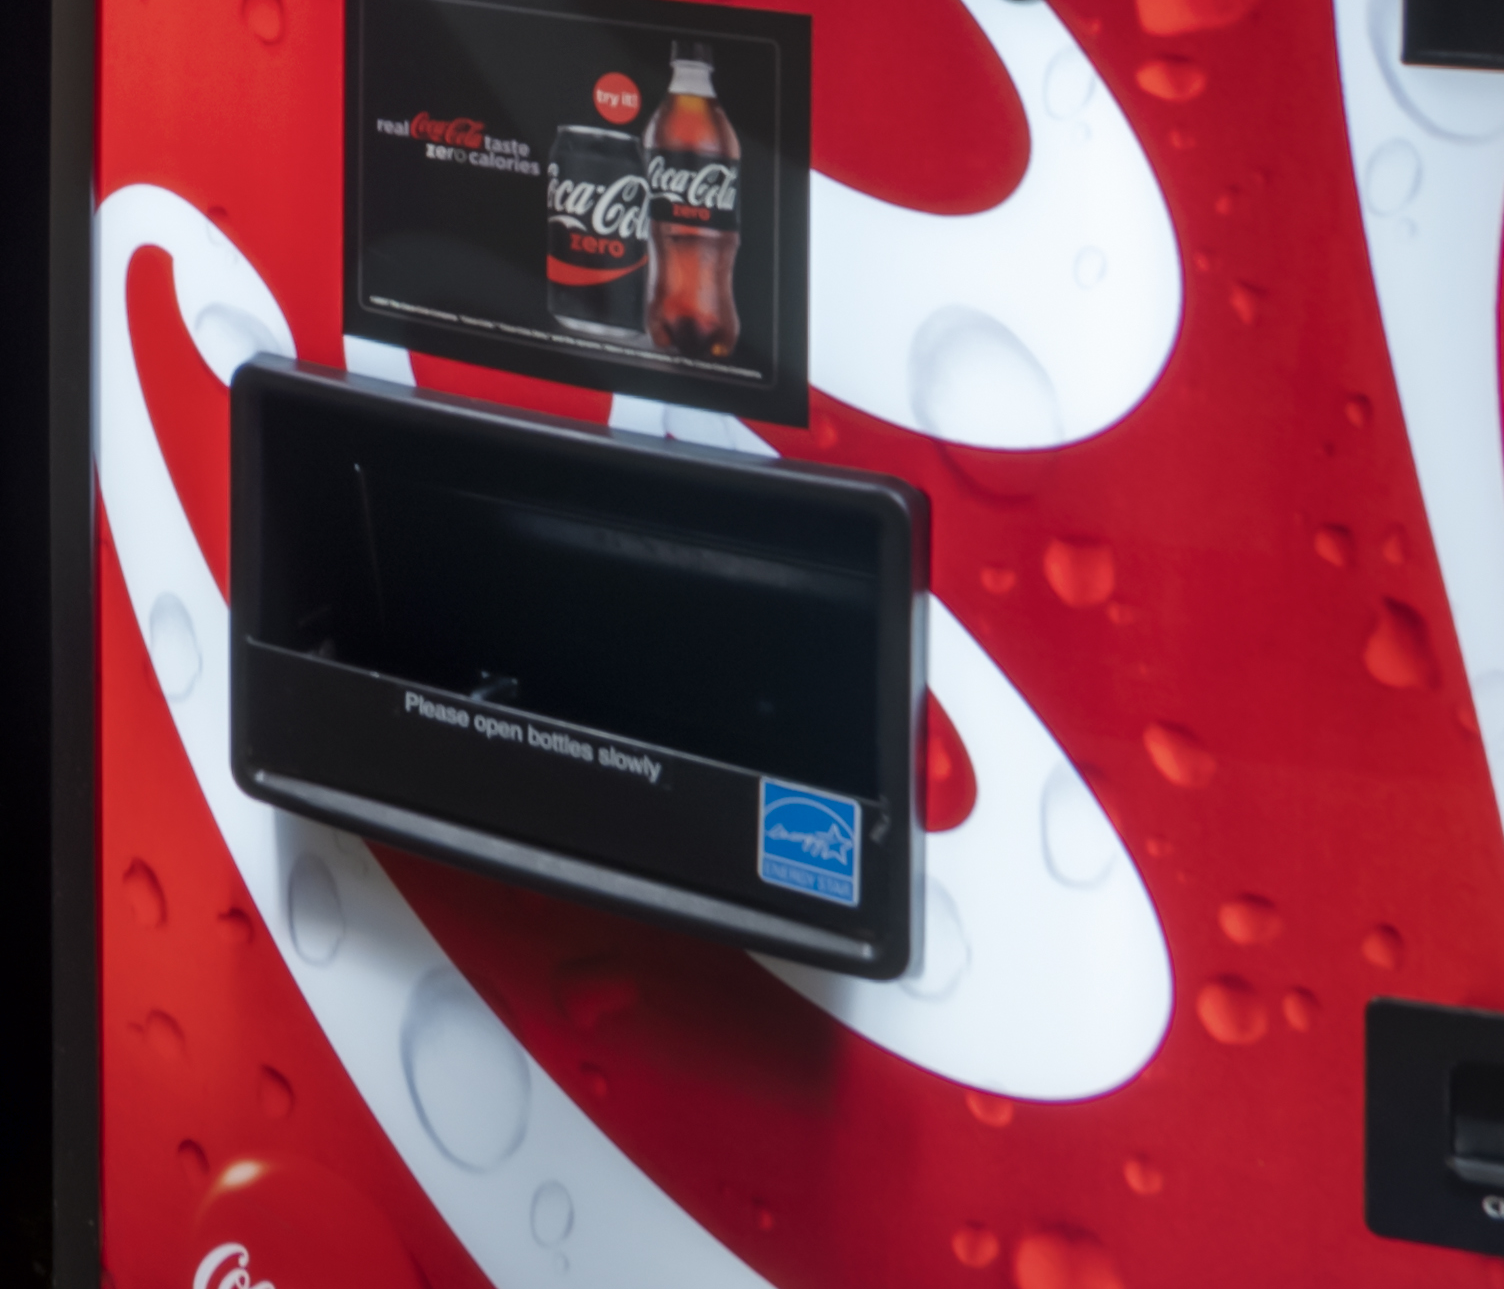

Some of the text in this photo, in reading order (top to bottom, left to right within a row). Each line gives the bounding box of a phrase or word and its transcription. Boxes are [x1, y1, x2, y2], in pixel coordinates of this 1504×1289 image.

[596, 88, 619, 107] try
[377, 111, 530, 158] real Coca-Cola taste
[425, 143, 541, 177] zero calories
[647, 157, 737, 211] Coca-Cola
[673, 204, 710, 222] zero
[570, 233, 625, 259] zero
[404, 690, 663, 783] Please open bottles slowly
